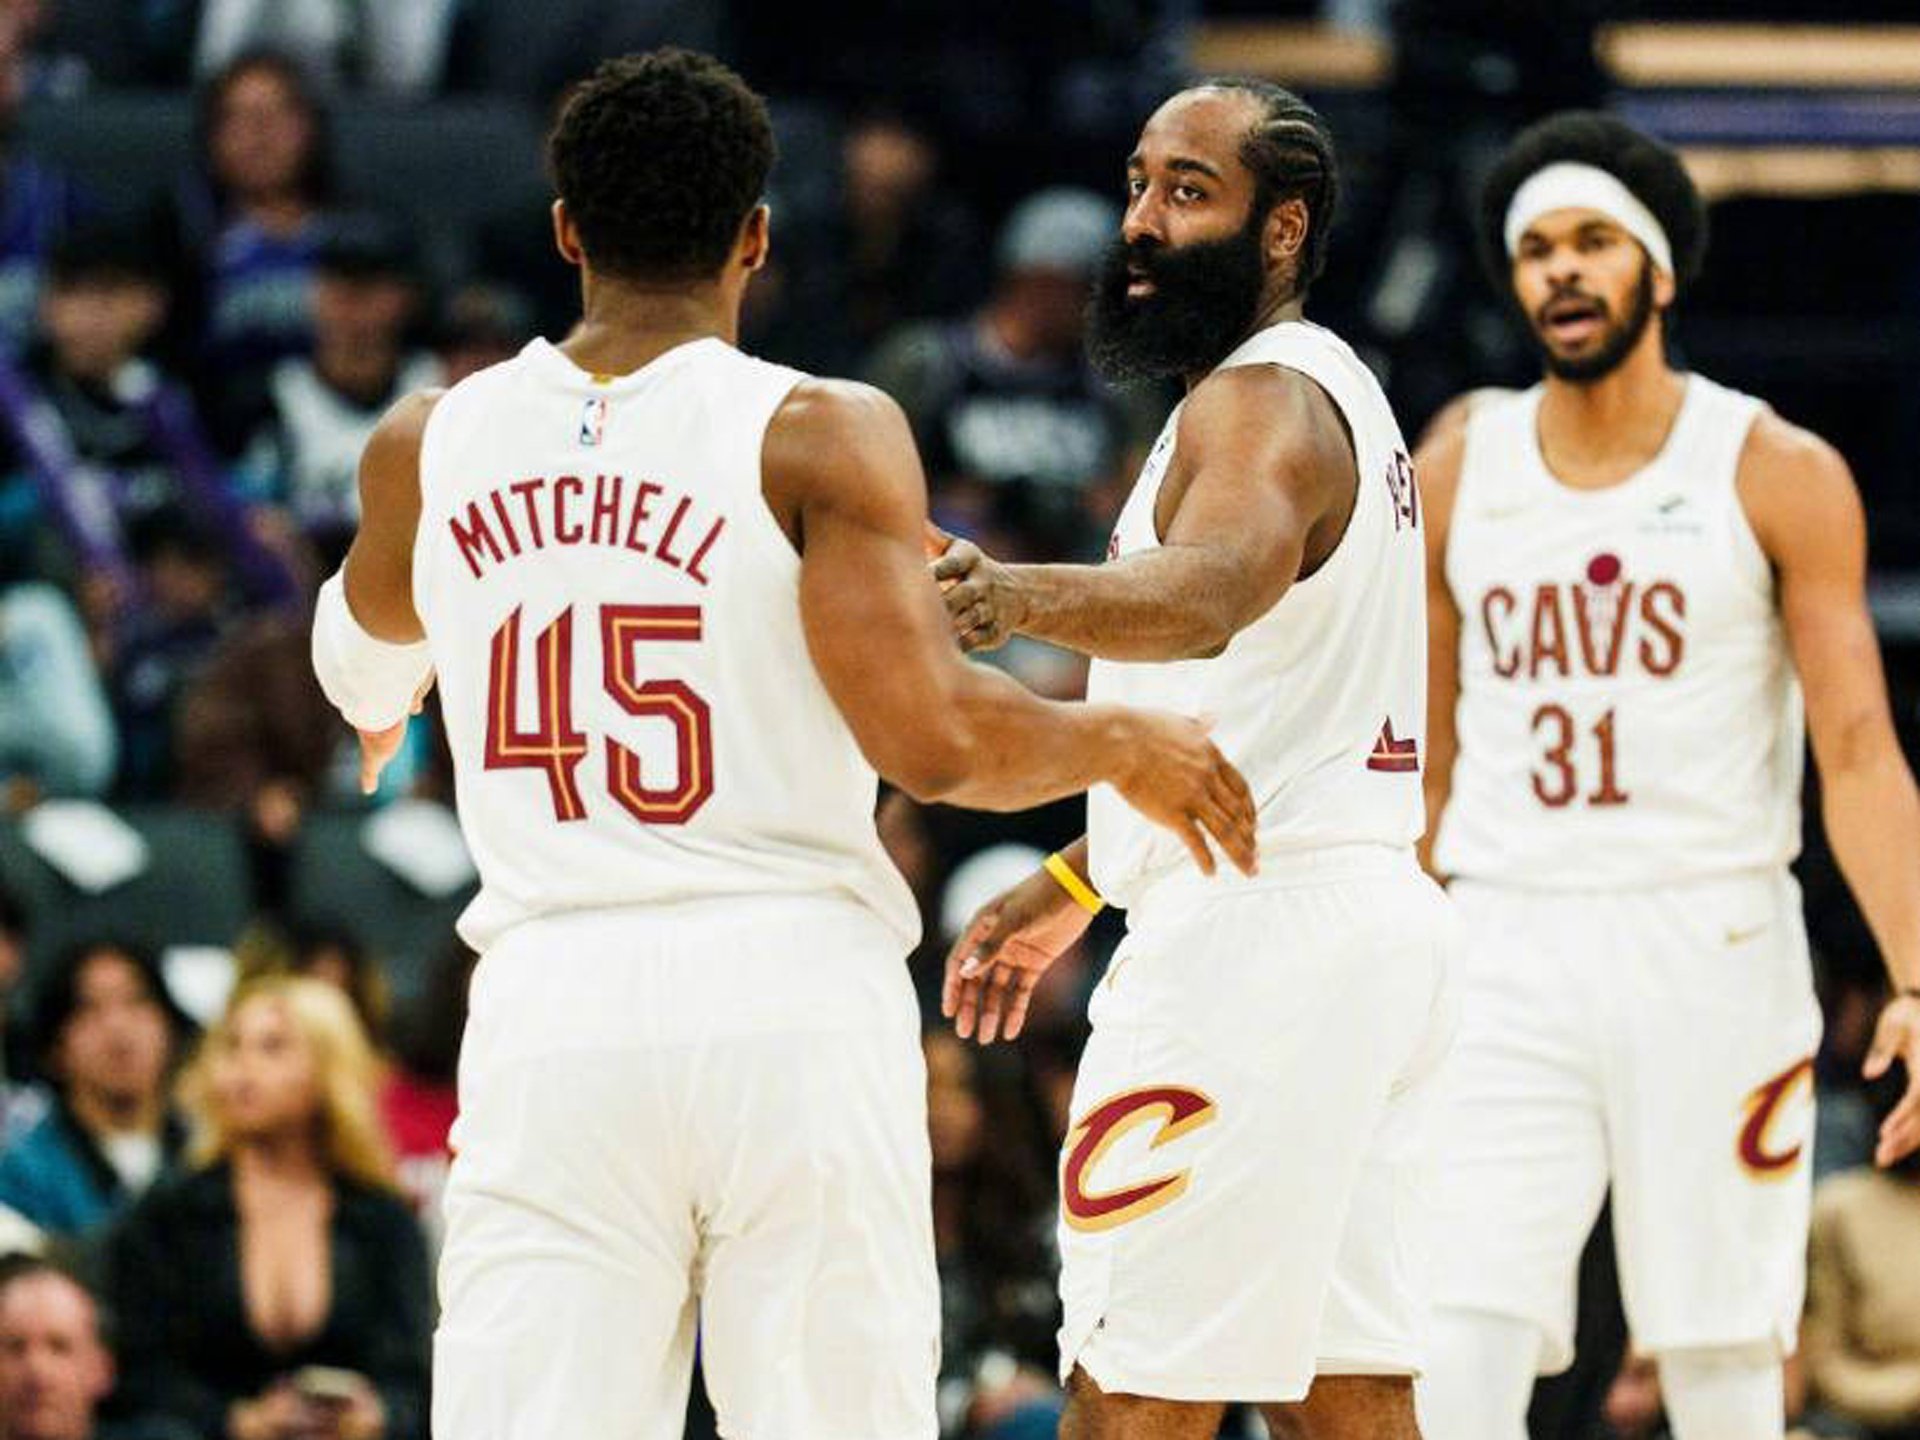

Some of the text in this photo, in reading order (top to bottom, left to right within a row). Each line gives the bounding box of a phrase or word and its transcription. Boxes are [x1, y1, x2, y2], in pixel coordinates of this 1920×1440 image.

[449, 475, 725, 586] MITCHELL
[1482, 581, 1686, 679] CAVS
[484, 603, 714, 824] 45
[1531, 704, 1629, 807] 31
[1064, 1085, 1217, 1232] C
